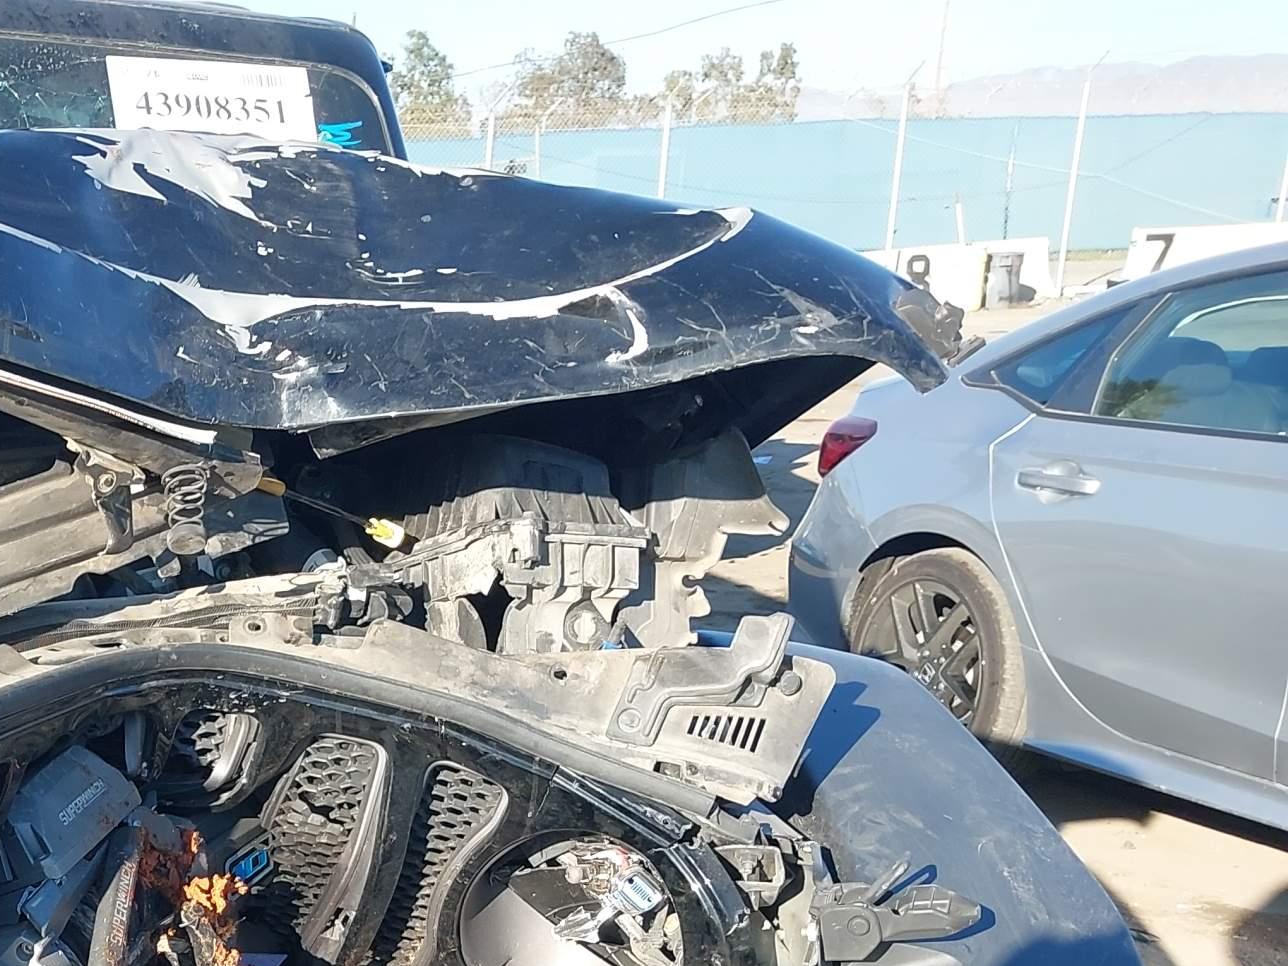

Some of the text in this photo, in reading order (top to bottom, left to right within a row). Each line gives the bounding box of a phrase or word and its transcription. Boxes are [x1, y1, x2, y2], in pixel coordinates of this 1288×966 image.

[135, 91, 286, 124] 43908351
[1146, 233, 1176, 272] 7
[58, 778, 105, 826] SUPERWINCH
[111, 860, 136, 947] SUPERWINCH
